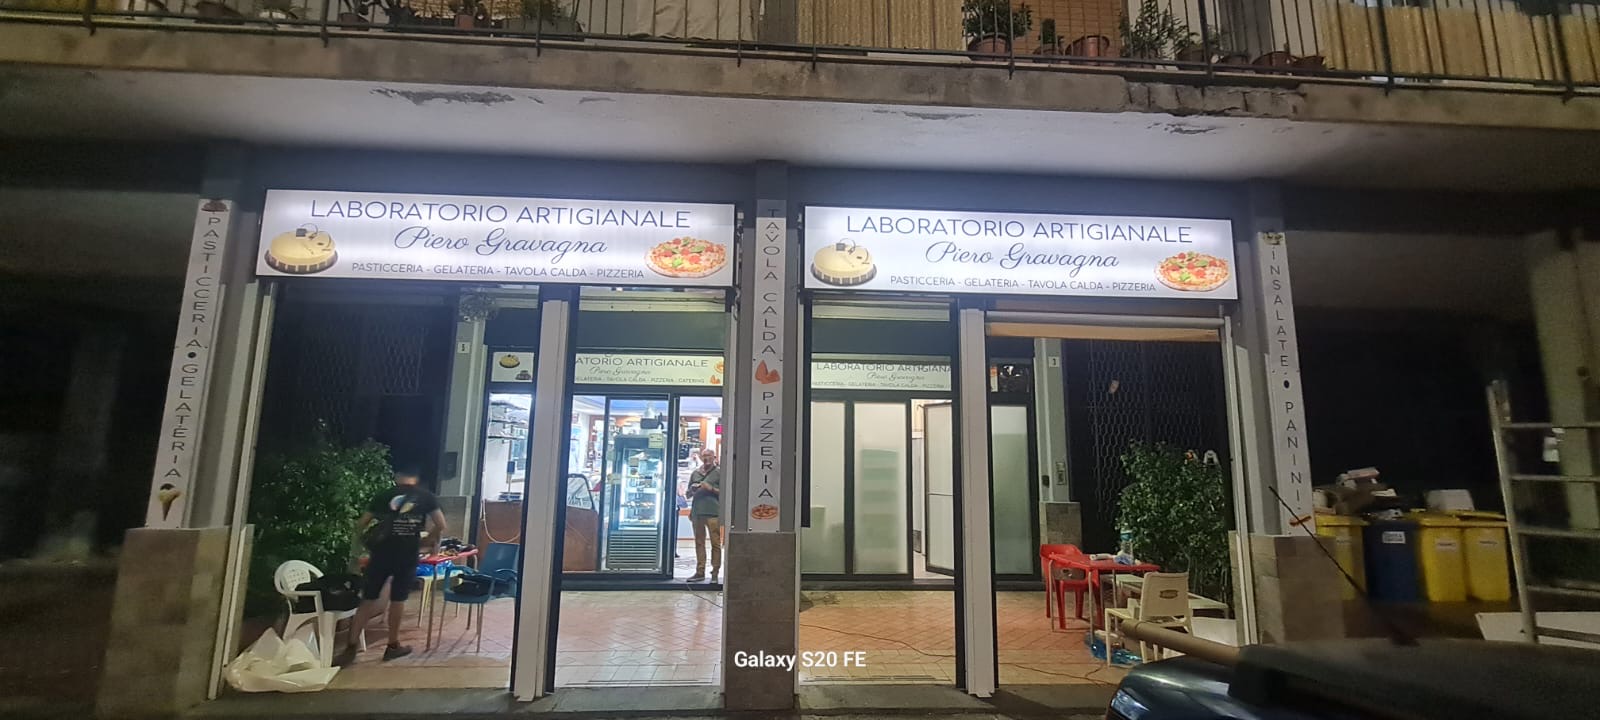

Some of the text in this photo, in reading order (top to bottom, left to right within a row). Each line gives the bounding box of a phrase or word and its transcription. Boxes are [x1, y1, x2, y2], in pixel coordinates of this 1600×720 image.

[311, 199, 691, 228] LABORATORIO ARTIGIANALE
[847, 215, 1193, 243] LABORATORIO ARTIGIANALE
[394, 225, 608, 264] Piero Gravagna
[925, 241, 1120, 278] Piero Gravagna
[352, 262, 424, 273] PASTICCERIA
[434, 265, 494, 275] GELATERIA
[504, 266, 548, 277] TAVOLA
[550, 267, 587, 277] CALDA
[597, 269, 645, 279] PIZZERIA
[761, 208, 781, 354] TAVOLA CALDA
[890, 275, 956, 286] PASTICCERIA
[964, 278, 1019, 288] GELATERIA
[1028, 279, 1068, 290] TAVOLA
[1070, 281, 1103, 290] CALDA
[1112, 282, 1156, 292] PIZZERIA
[165, 217, 221, 477] PASTICCERIA GELATERIA
[576, 357, 709, 368] ATORIO ARTIGIANALE
[816, 363, 951, 373] LABORATORIO ARTIGIANA
[1270, 250, 1302, 501] INSALATE PANINI
[758, 391, 774, 498] PIZZERIA
